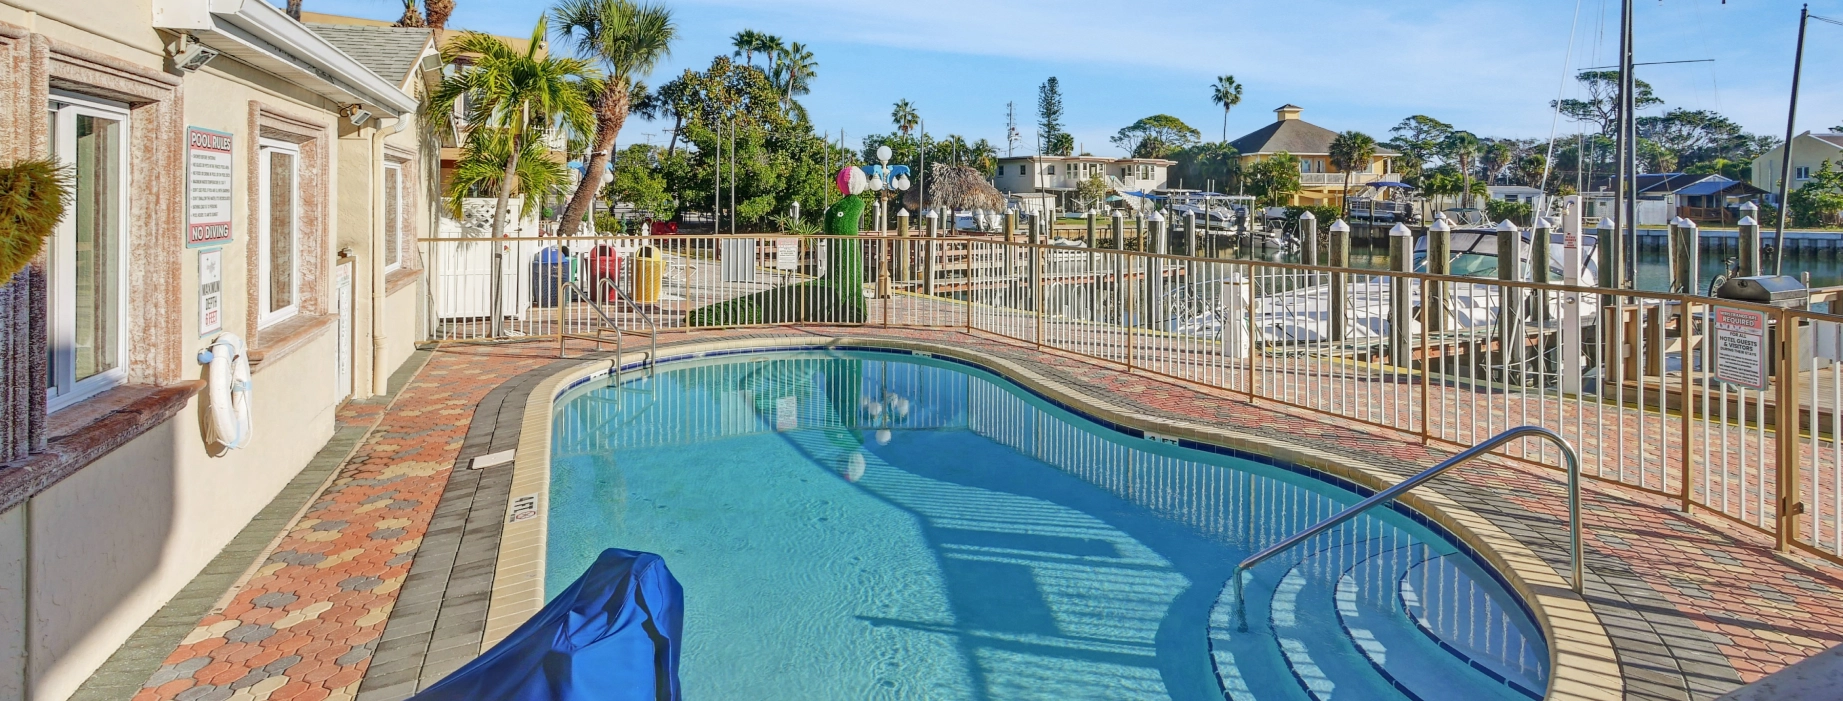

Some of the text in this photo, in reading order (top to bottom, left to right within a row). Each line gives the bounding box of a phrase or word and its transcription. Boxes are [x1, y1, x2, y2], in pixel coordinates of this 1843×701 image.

[191, 131, 231, 151] POOL RULES
[192, 224, 229, 241] NO DIVING
[209, 310, 217, 325] FEET
[1722, 316, 1755, 326] REQUIRED
[1729, 343, 1753, 351] VISITORS
[1736, 338, 1757, 347] GUESTS
